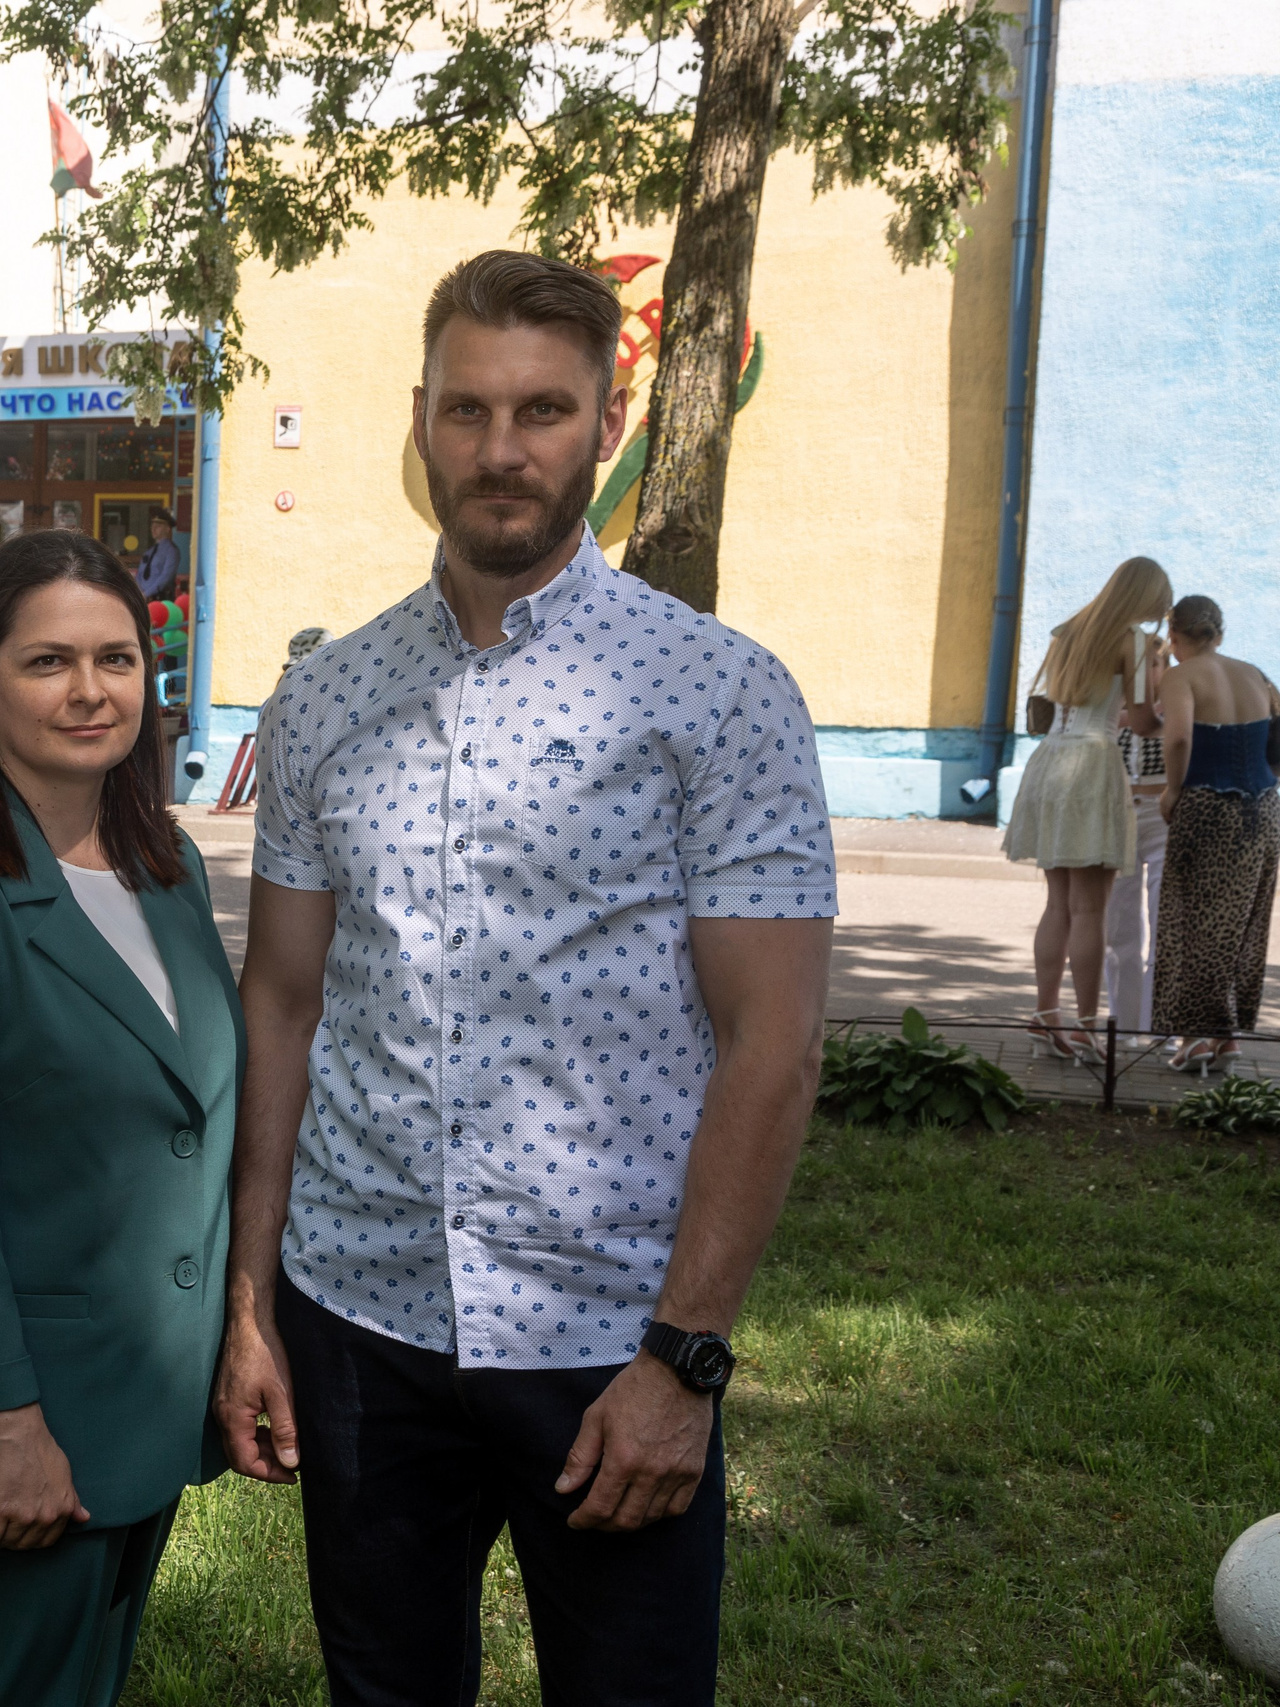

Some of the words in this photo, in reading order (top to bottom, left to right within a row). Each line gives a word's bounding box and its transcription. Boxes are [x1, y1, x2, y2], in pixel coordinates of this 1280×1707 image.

[37, 341, 193, 377] ШКА
[1, 393, 56, 414] ЧТО
[67, 391, 122, 412] НАС
